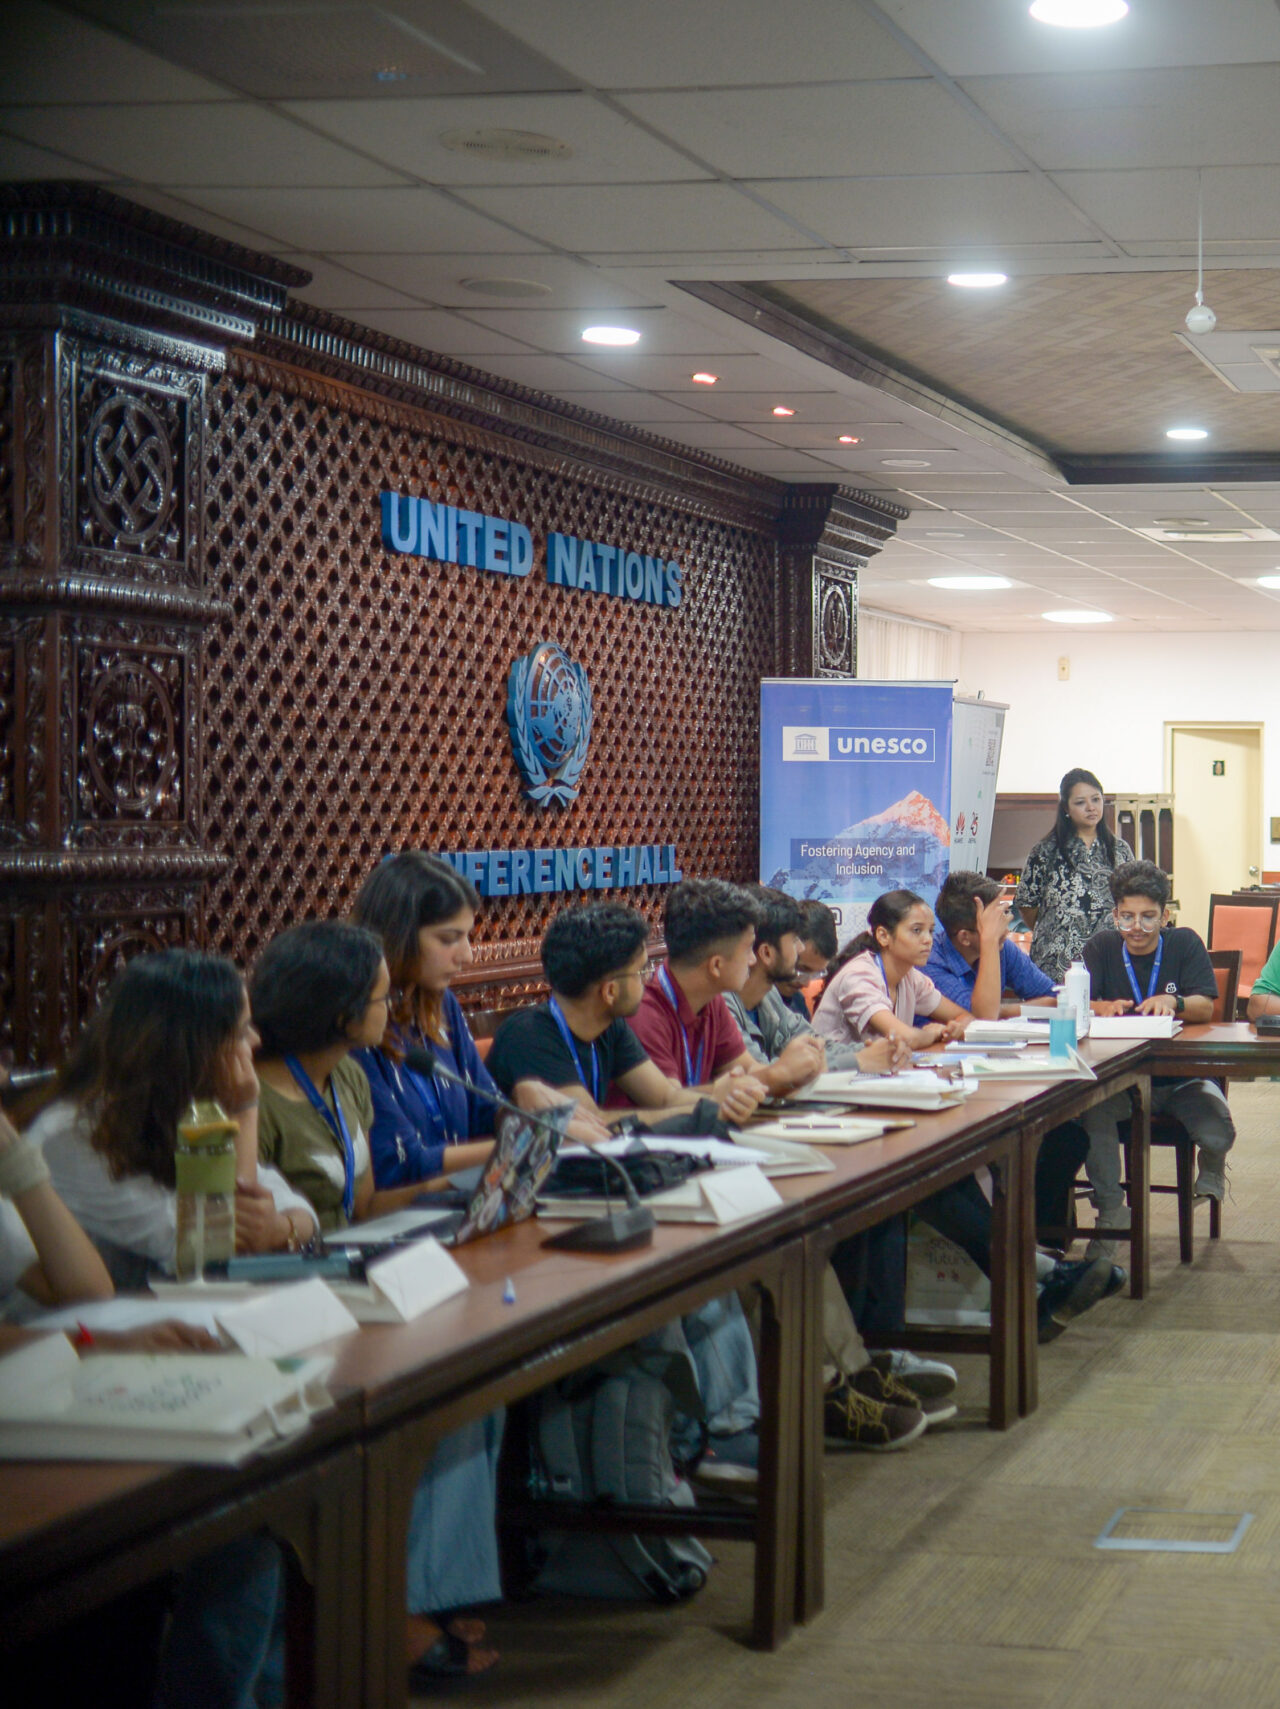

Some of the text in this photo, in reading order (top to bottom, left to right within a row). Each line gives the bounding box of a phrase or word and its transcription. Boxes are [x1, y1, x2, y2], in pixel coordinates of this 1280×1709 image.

[380, 491, 682, 608] UNITED NATIONS
[837, 737, 928, 755] unesco
[801, 844, 915, 859] Fostering Agency and
[385, 844, 682, 896] NFERENCE HALL
[836, 862, 883, 875] Inclusion
